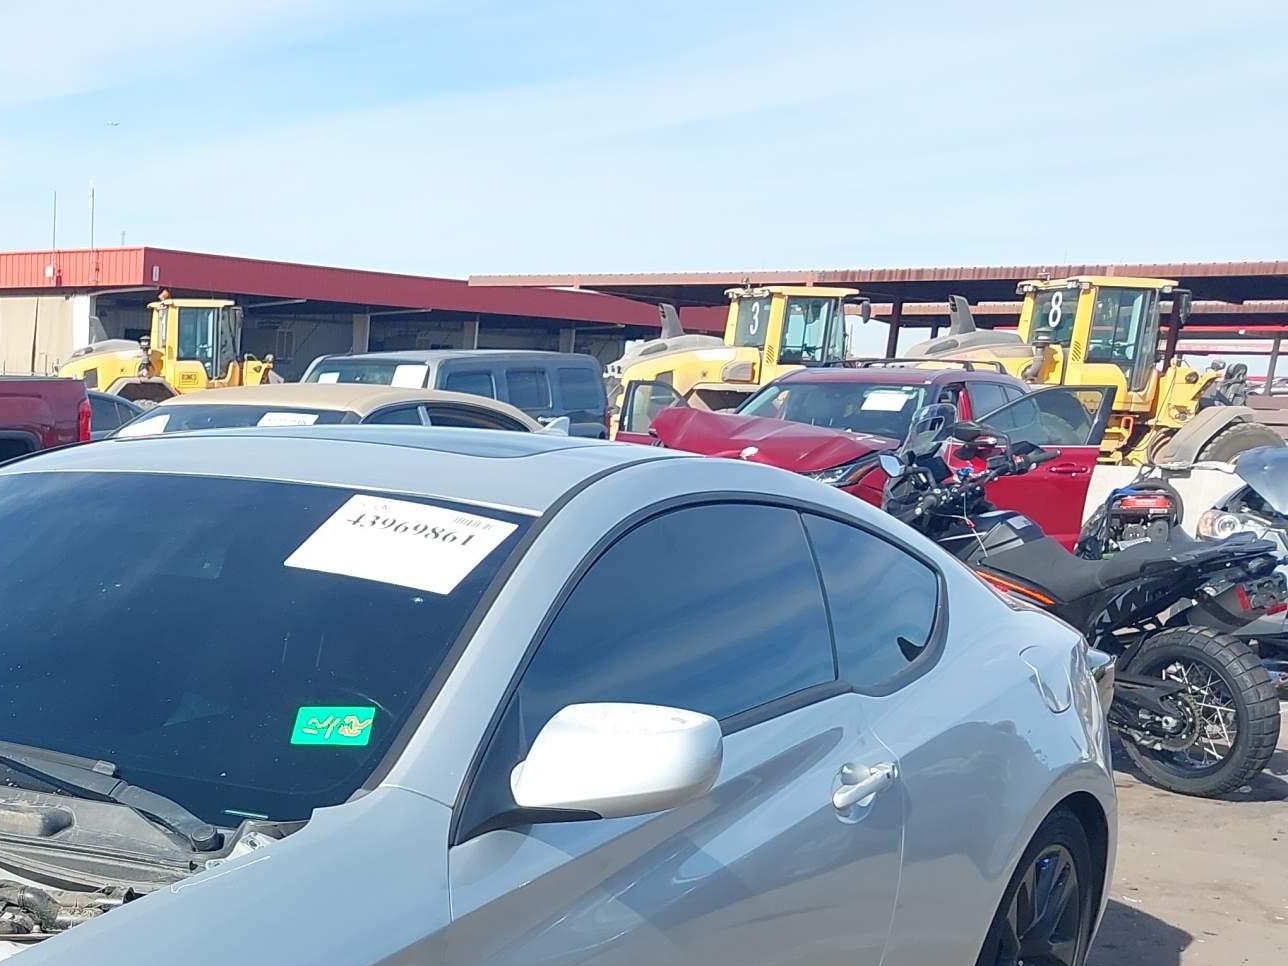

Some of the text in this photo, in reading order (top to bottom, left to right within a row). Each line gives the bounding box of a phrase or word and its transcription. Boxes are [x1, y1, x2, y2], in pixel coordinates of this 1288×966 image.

[749, 301, 760, 335] 3
[1049, 291, 1062, 328] 8
[346, 512, 476, 547] 43969861
